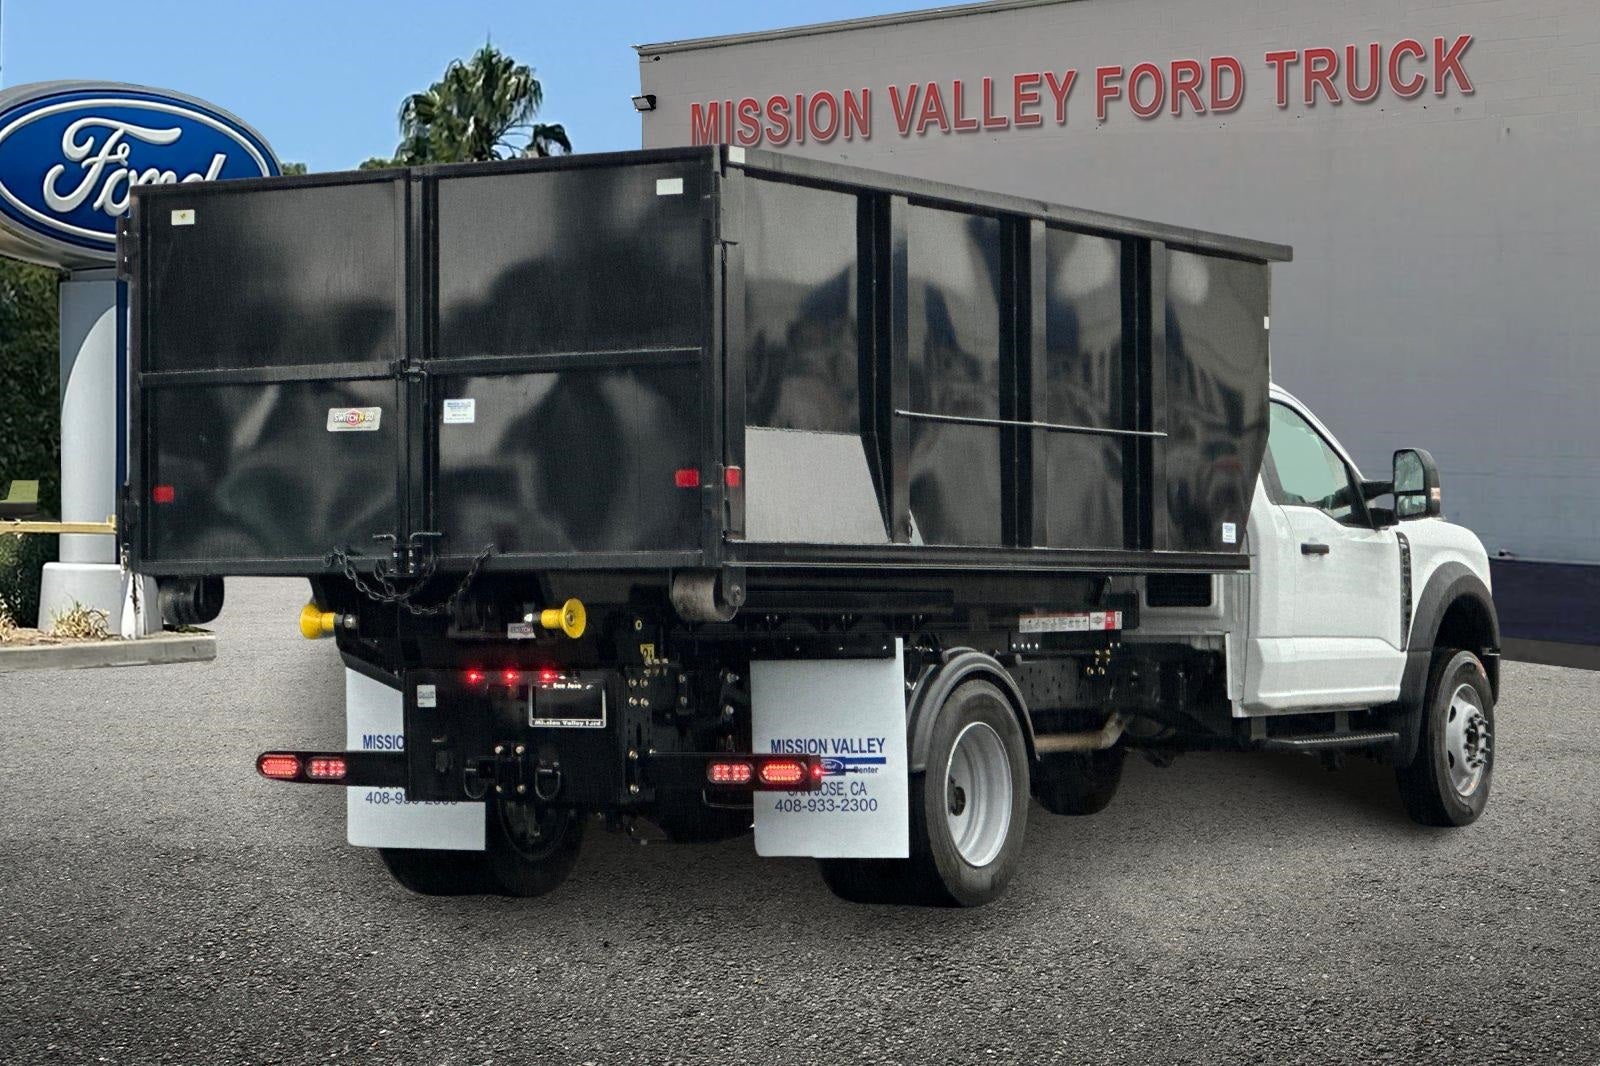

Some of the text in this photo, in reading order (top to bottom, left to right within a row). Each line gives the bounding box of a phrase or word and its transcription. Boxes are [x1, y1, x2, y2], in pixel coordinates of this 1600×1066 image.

[690, 34, 1473, 146] MISSION VALLEY FORD TRUCK
[770, 738, 885, 754] MISSION VALLEY
[850, 781, 867, 796] CA
[774, 798, 878, 813] 408-933-2300
